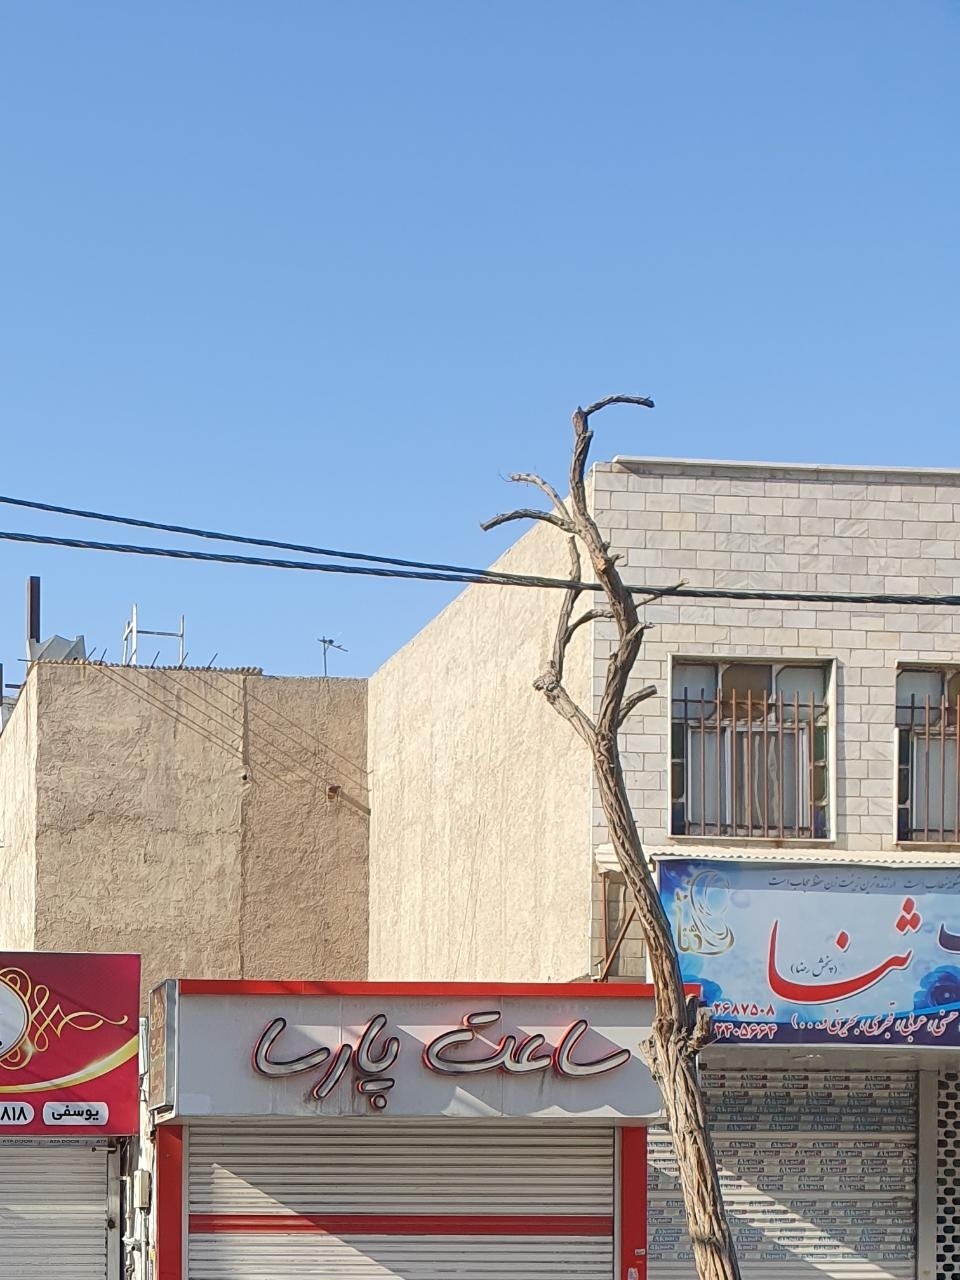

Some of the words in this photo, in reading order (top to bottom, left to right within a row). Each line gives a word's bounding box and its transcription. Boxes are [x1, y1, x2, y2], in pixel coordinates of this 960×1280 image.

[253, 1014, 400, 1109] پارسا
[423, 1010, 632, 1077] ساعت
[51, 1104, 100, 1121] یوسفی
